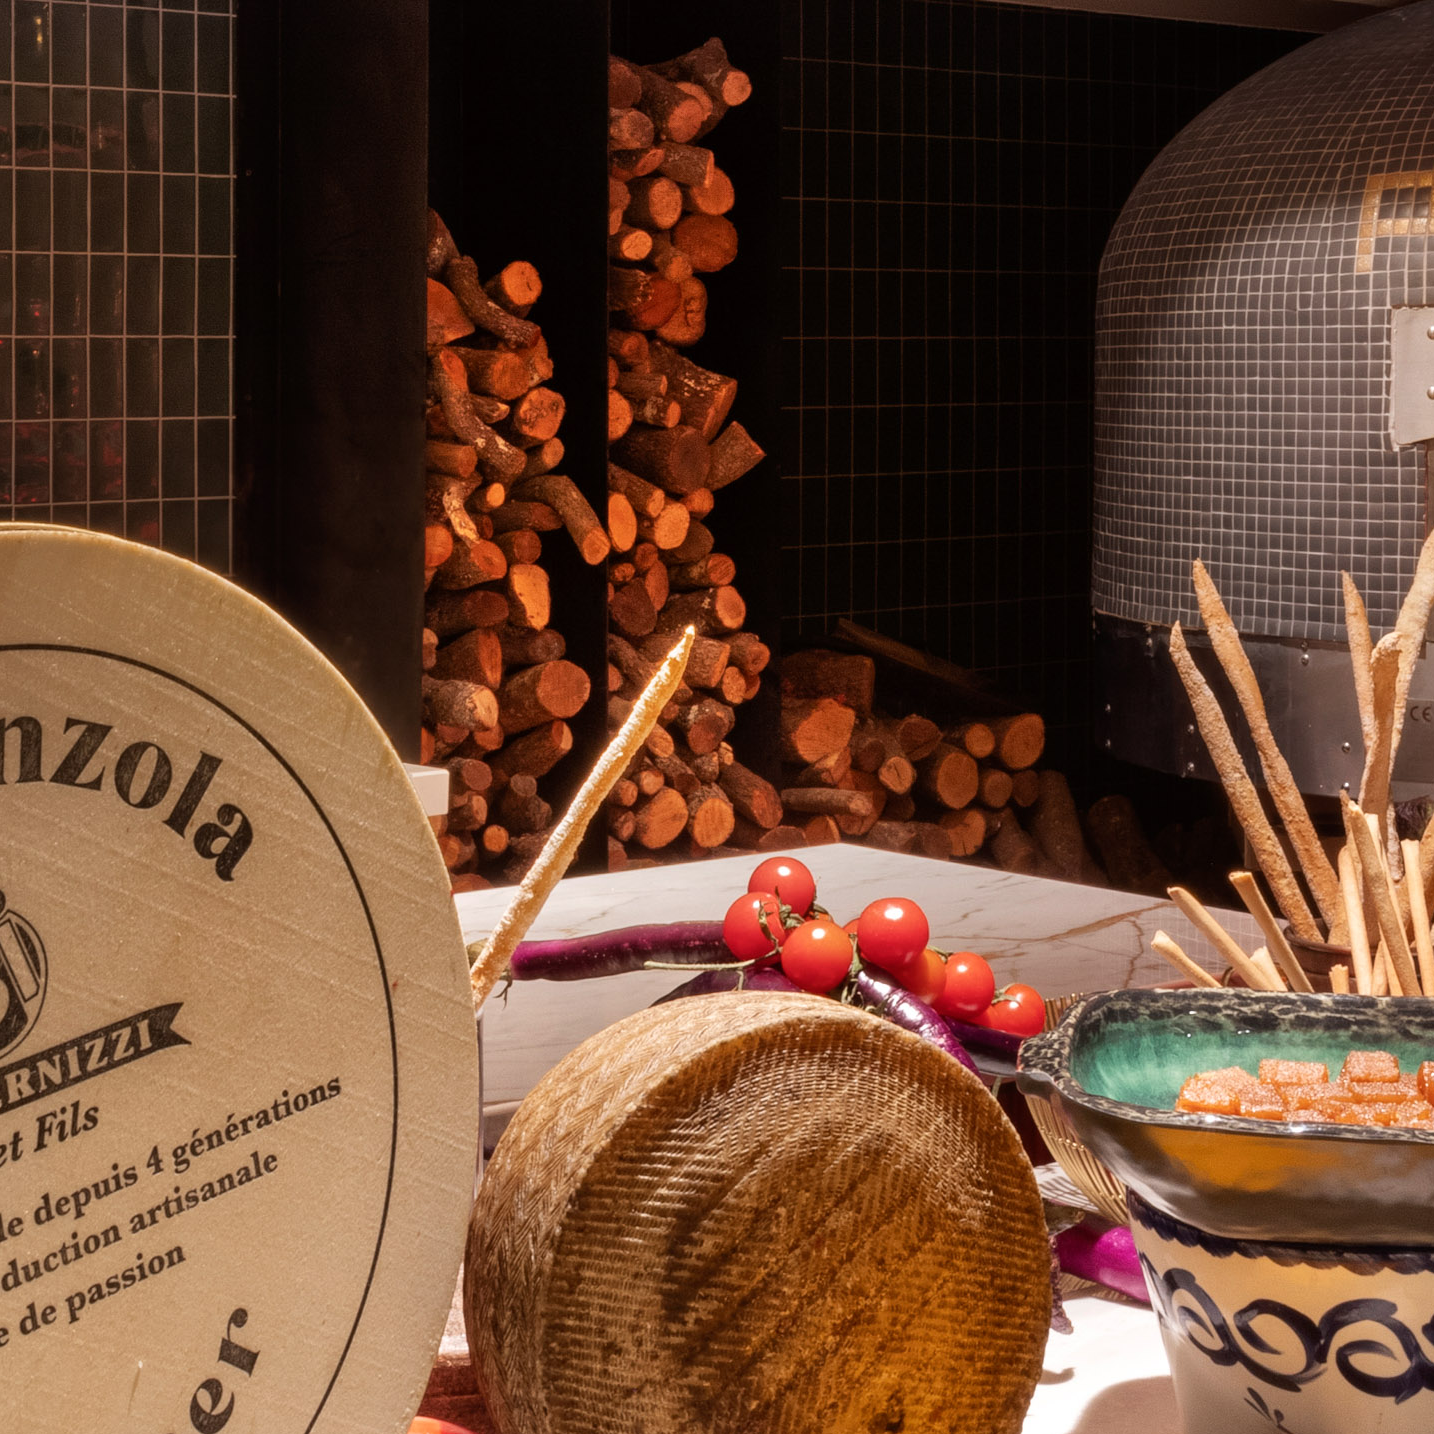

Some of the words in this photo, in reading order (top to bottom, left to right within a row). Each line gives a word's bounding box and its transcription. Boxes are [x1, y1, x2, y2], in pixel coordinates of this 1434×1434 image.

[1410, 705, 1432, 722] CE
[33, 1100, 99, 1152] Fils
[34, 1162, 138, 1225] depuis
[146, 1145, 164, 1176] 4
[172, 1075, 342, 1174] générations
[129, 1150, 279, 1235] artisanale
[19, 1301, 57, 1335] de
[65, 1244, 186, 1324] passion
